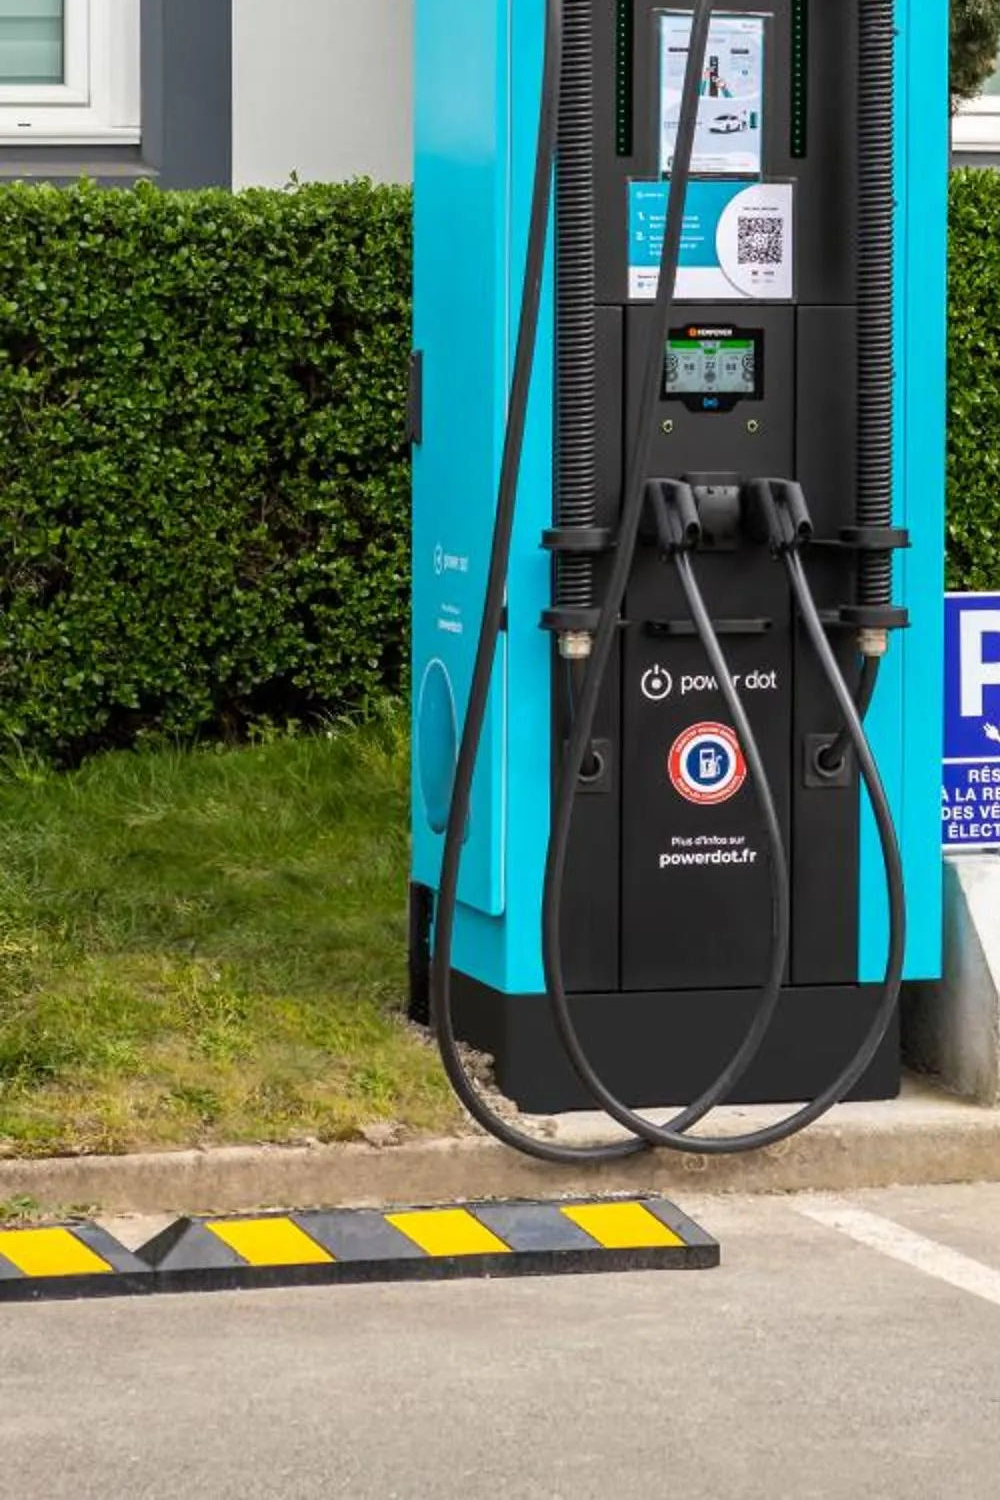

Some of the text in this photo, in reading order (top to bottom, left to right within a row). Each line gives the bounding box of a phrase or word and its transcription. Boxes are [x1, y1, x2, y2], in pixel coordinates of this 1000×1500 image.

[680, 669, 778, 696] powr dot
[955, 787, 977, 802] LA
[941, 805, 974, 821] DES
[671, 836, 693, 846] Plus
[729, 835, 745, 845] sur
[659, 848, 757, 868] powerdot.fr
